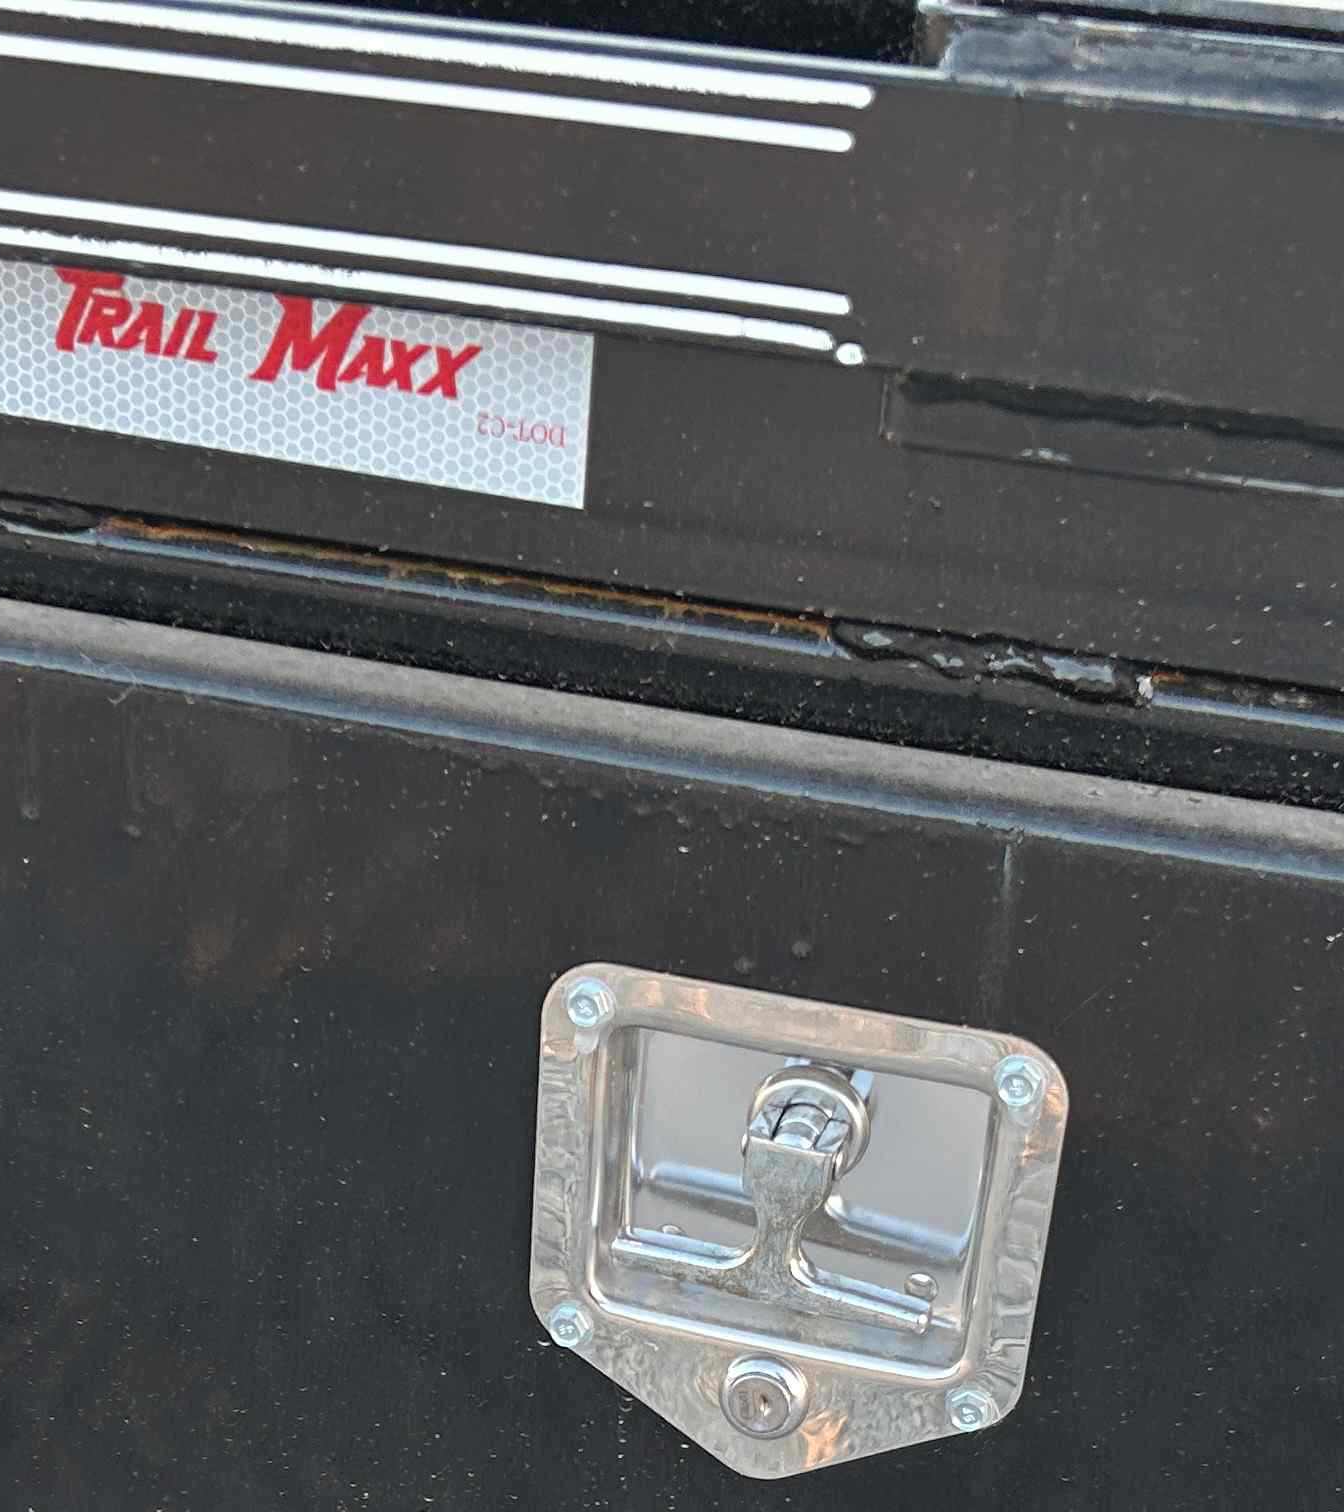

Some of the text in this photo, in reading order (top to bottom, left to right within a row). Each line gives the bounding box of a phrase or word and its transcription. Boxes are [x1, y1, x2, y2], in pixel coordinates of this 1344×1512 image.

[56, 266, 482, 399] TRAIL MAXX
[477, 410, 567, 448] DOT-C2
